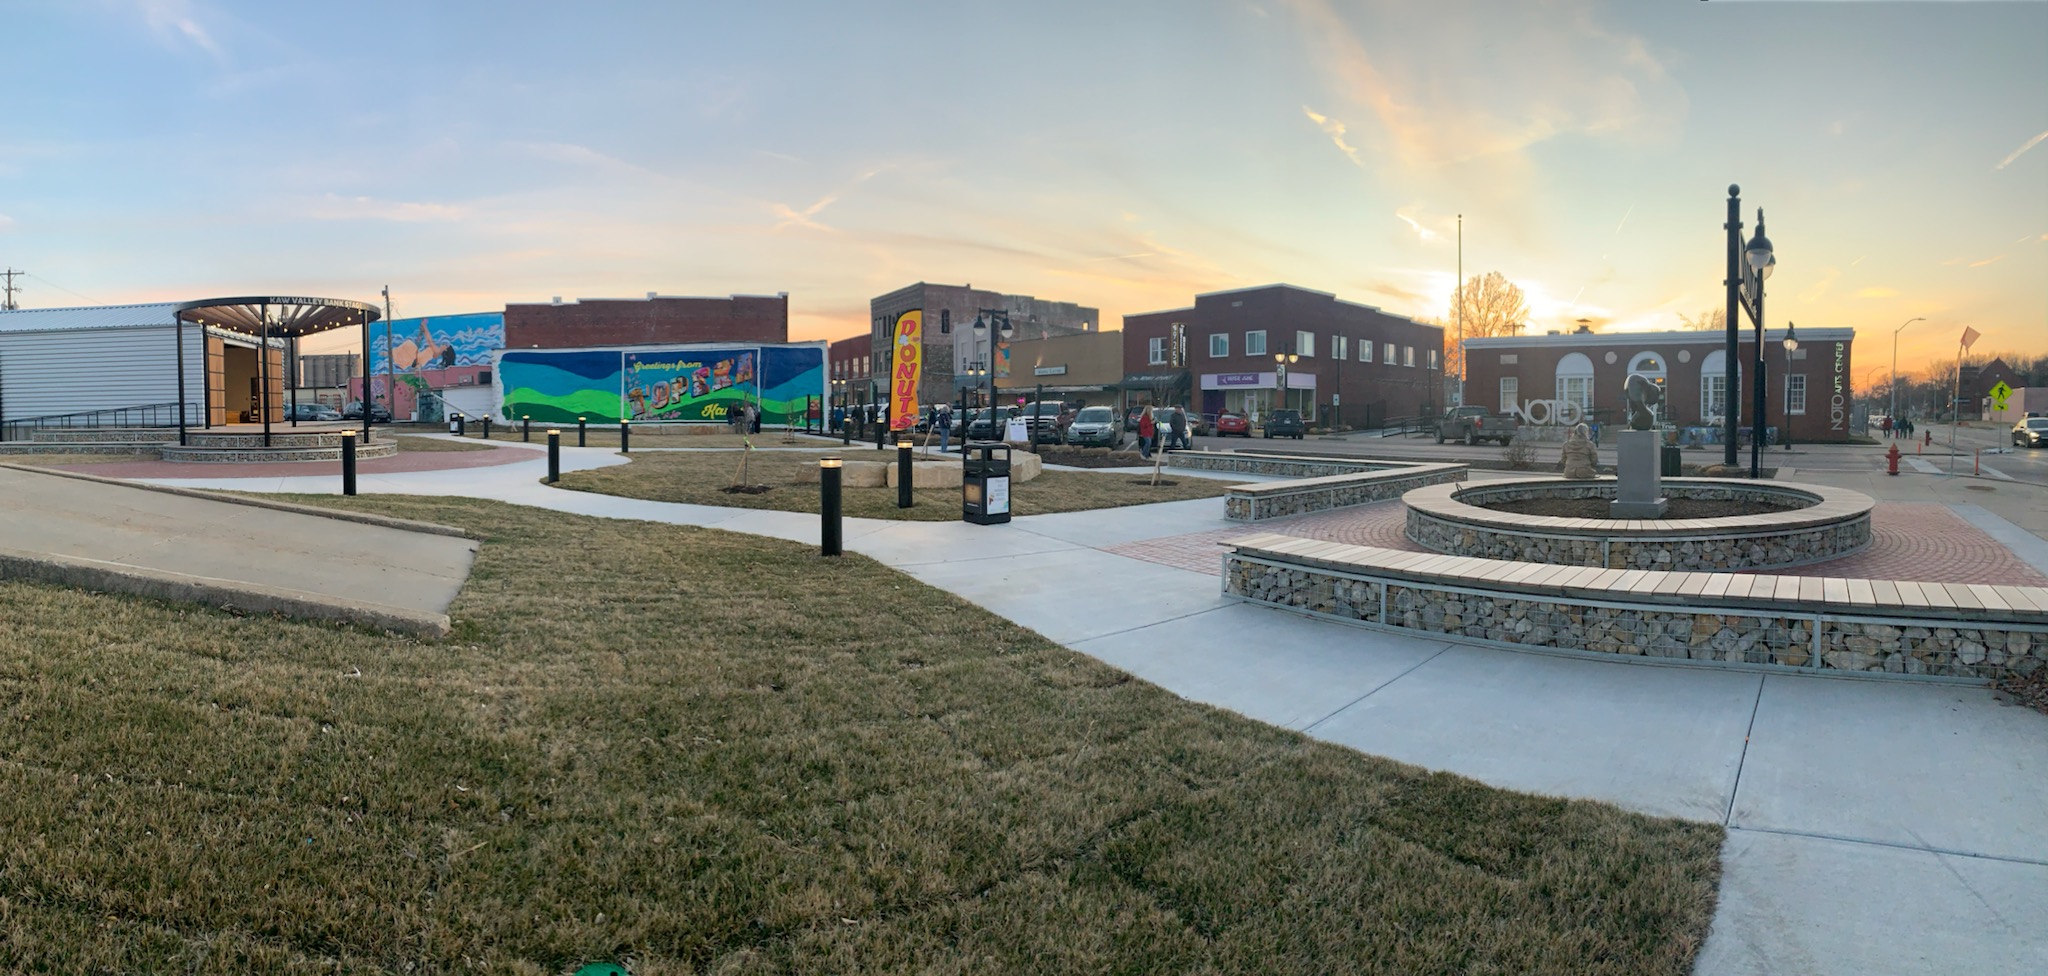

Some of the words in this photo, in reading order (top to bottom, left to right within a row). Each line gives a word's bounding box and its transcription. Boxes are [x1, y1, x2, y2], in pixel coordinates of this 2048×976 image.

[269, 296, 292, 304] KAW
[292, 297, 323, 305] VALLEY
[324, 299, 344, 308] BANK
[633, 361, 675, 373] Greetings
[676, 360, 703, 371] from
[1835, 342, 1844, 372] CENTER
[628, 352, 754, 418] TOPEKA
[896, 319, 917, 428] DONUTS
[1835, 376, 1843, 394] ARTS
[1510, 399, 1582, 426] NOTO
[1831, 394, 1844, 430] NOTO
